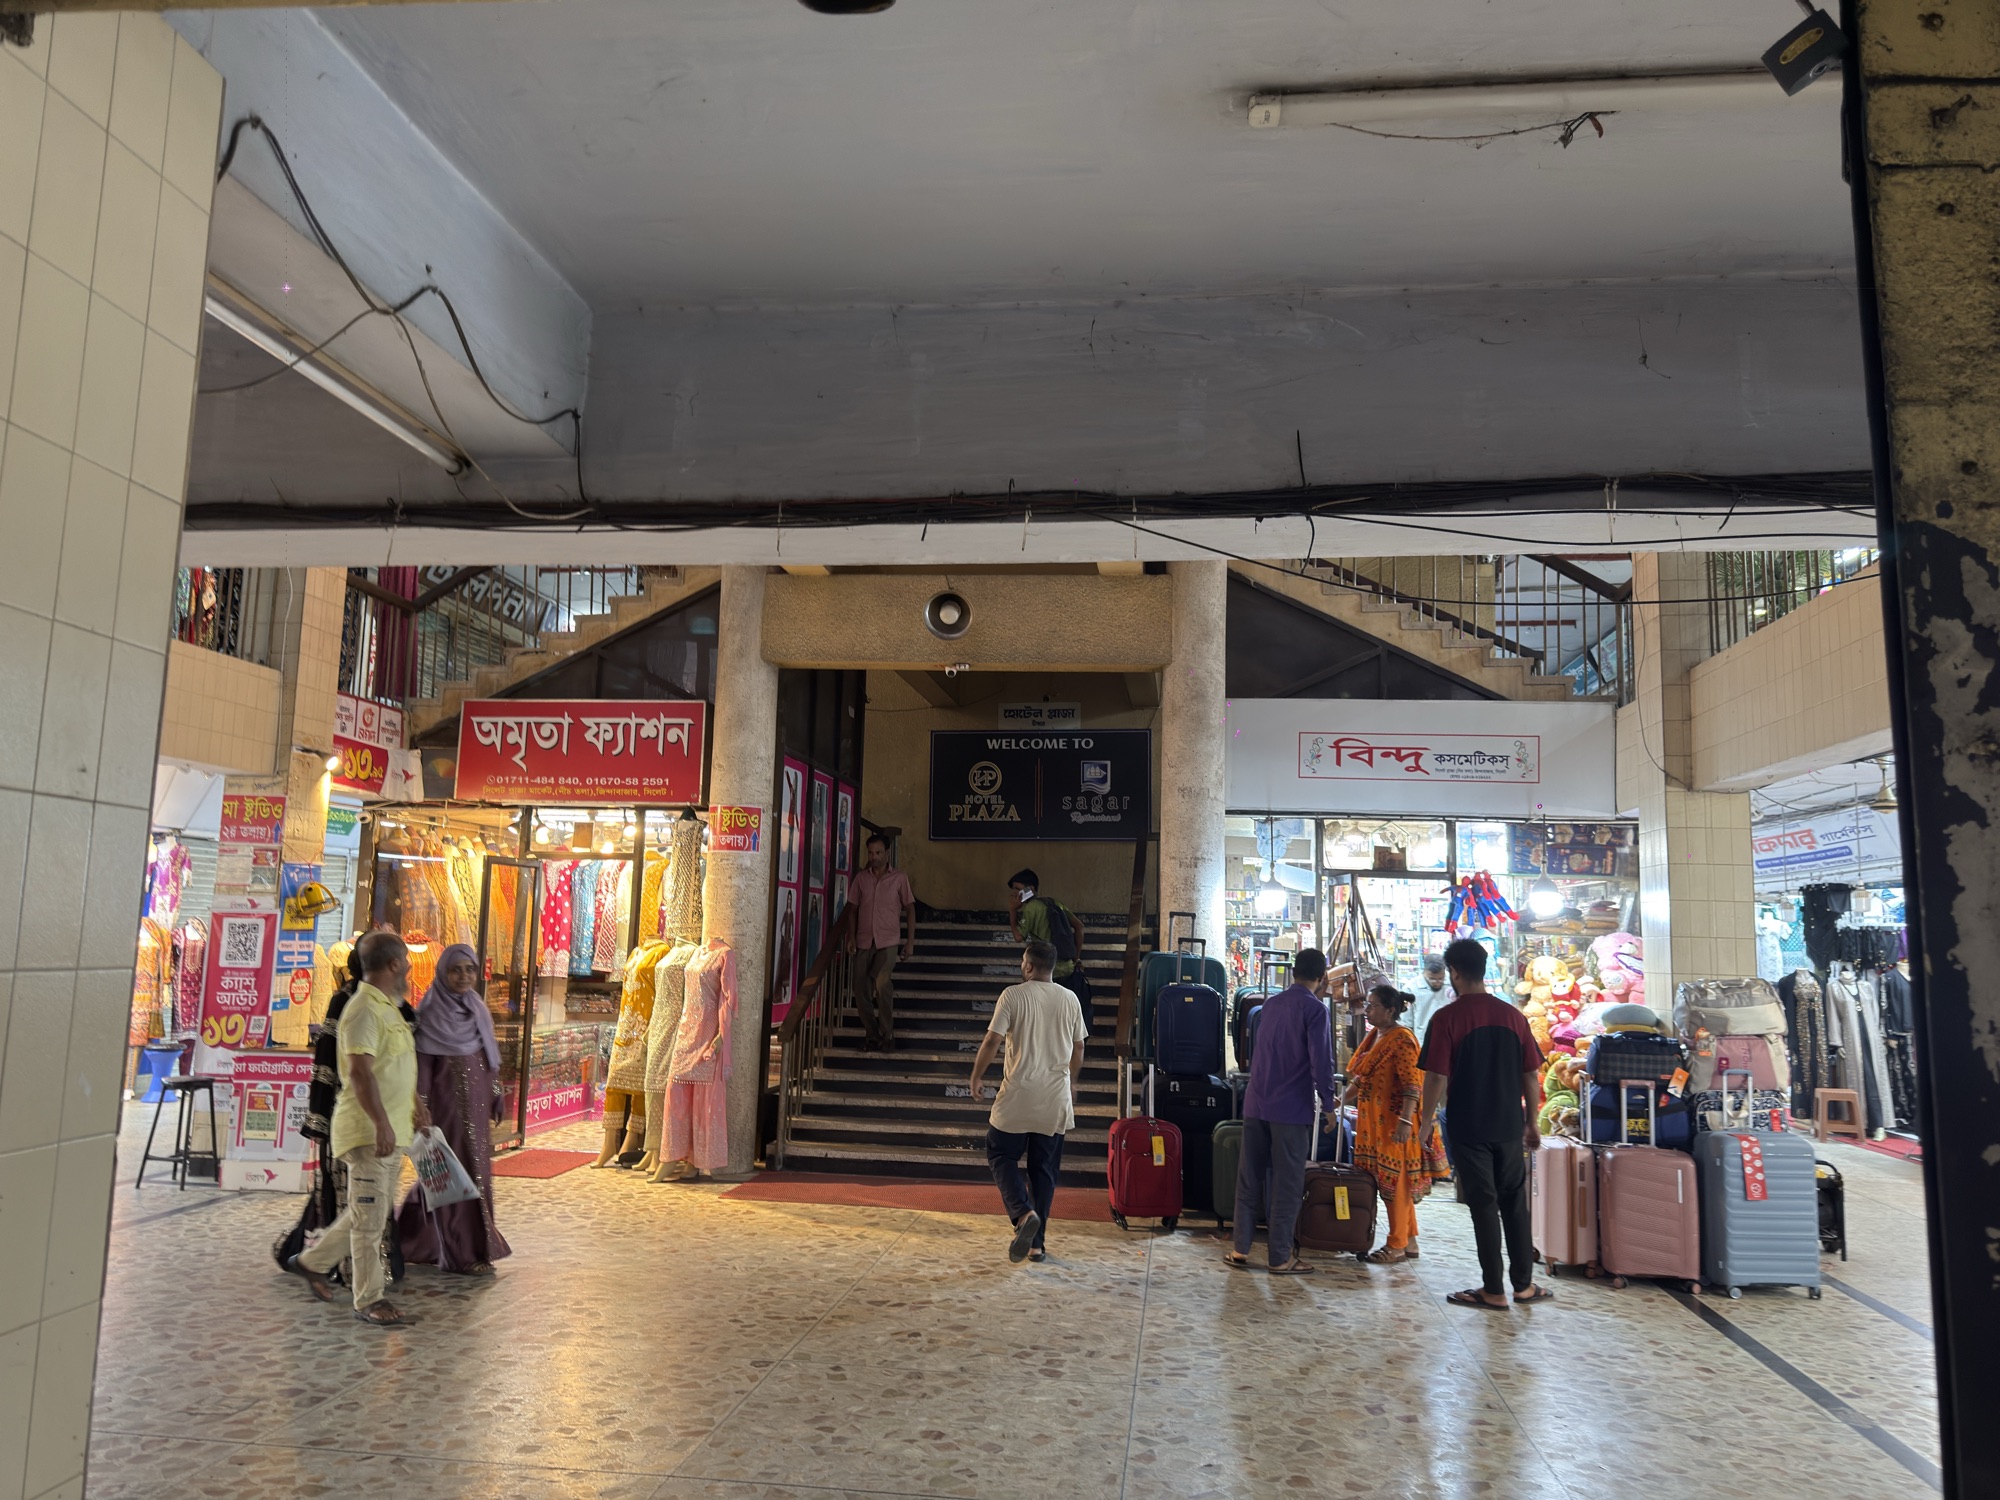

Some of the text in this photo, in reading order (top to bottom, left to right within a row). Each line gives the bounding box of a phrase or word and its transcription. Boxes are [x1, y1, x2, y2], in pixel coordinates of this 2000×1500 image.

[1004, 705, 1076, 719] হোটেল প্লাজা
[470, 711, 695, 773] অমৃতা ফ্যাশন
[987, 738, 1094, 750] WELCOME TO
[1328, 738, 1510, 775] বিন্দু কসমেটিকস্
[497, 775, 670, 787] 01711-484 840, 01670-58 2591
[483, 785, 506, 795] সিলেট
[643, 787, 667, 797] সিলেট
[965, 794, 1005, 805] HOTEL
[1062, 796, 1130, 813] sagar
[223, 799, 240, 819] মা
[328, 809, 357, 824] ashion
[949, 804, 1022, 822] PLAZA
[220, 976, 256, 991] ক্যাশ
[216, 990, 258, 1006] আউট
[248, 1060, 294, 1075] ফটোগ্রাফি
[526, 1087, 583, 1120] অমৃতা ফ্যাশন
